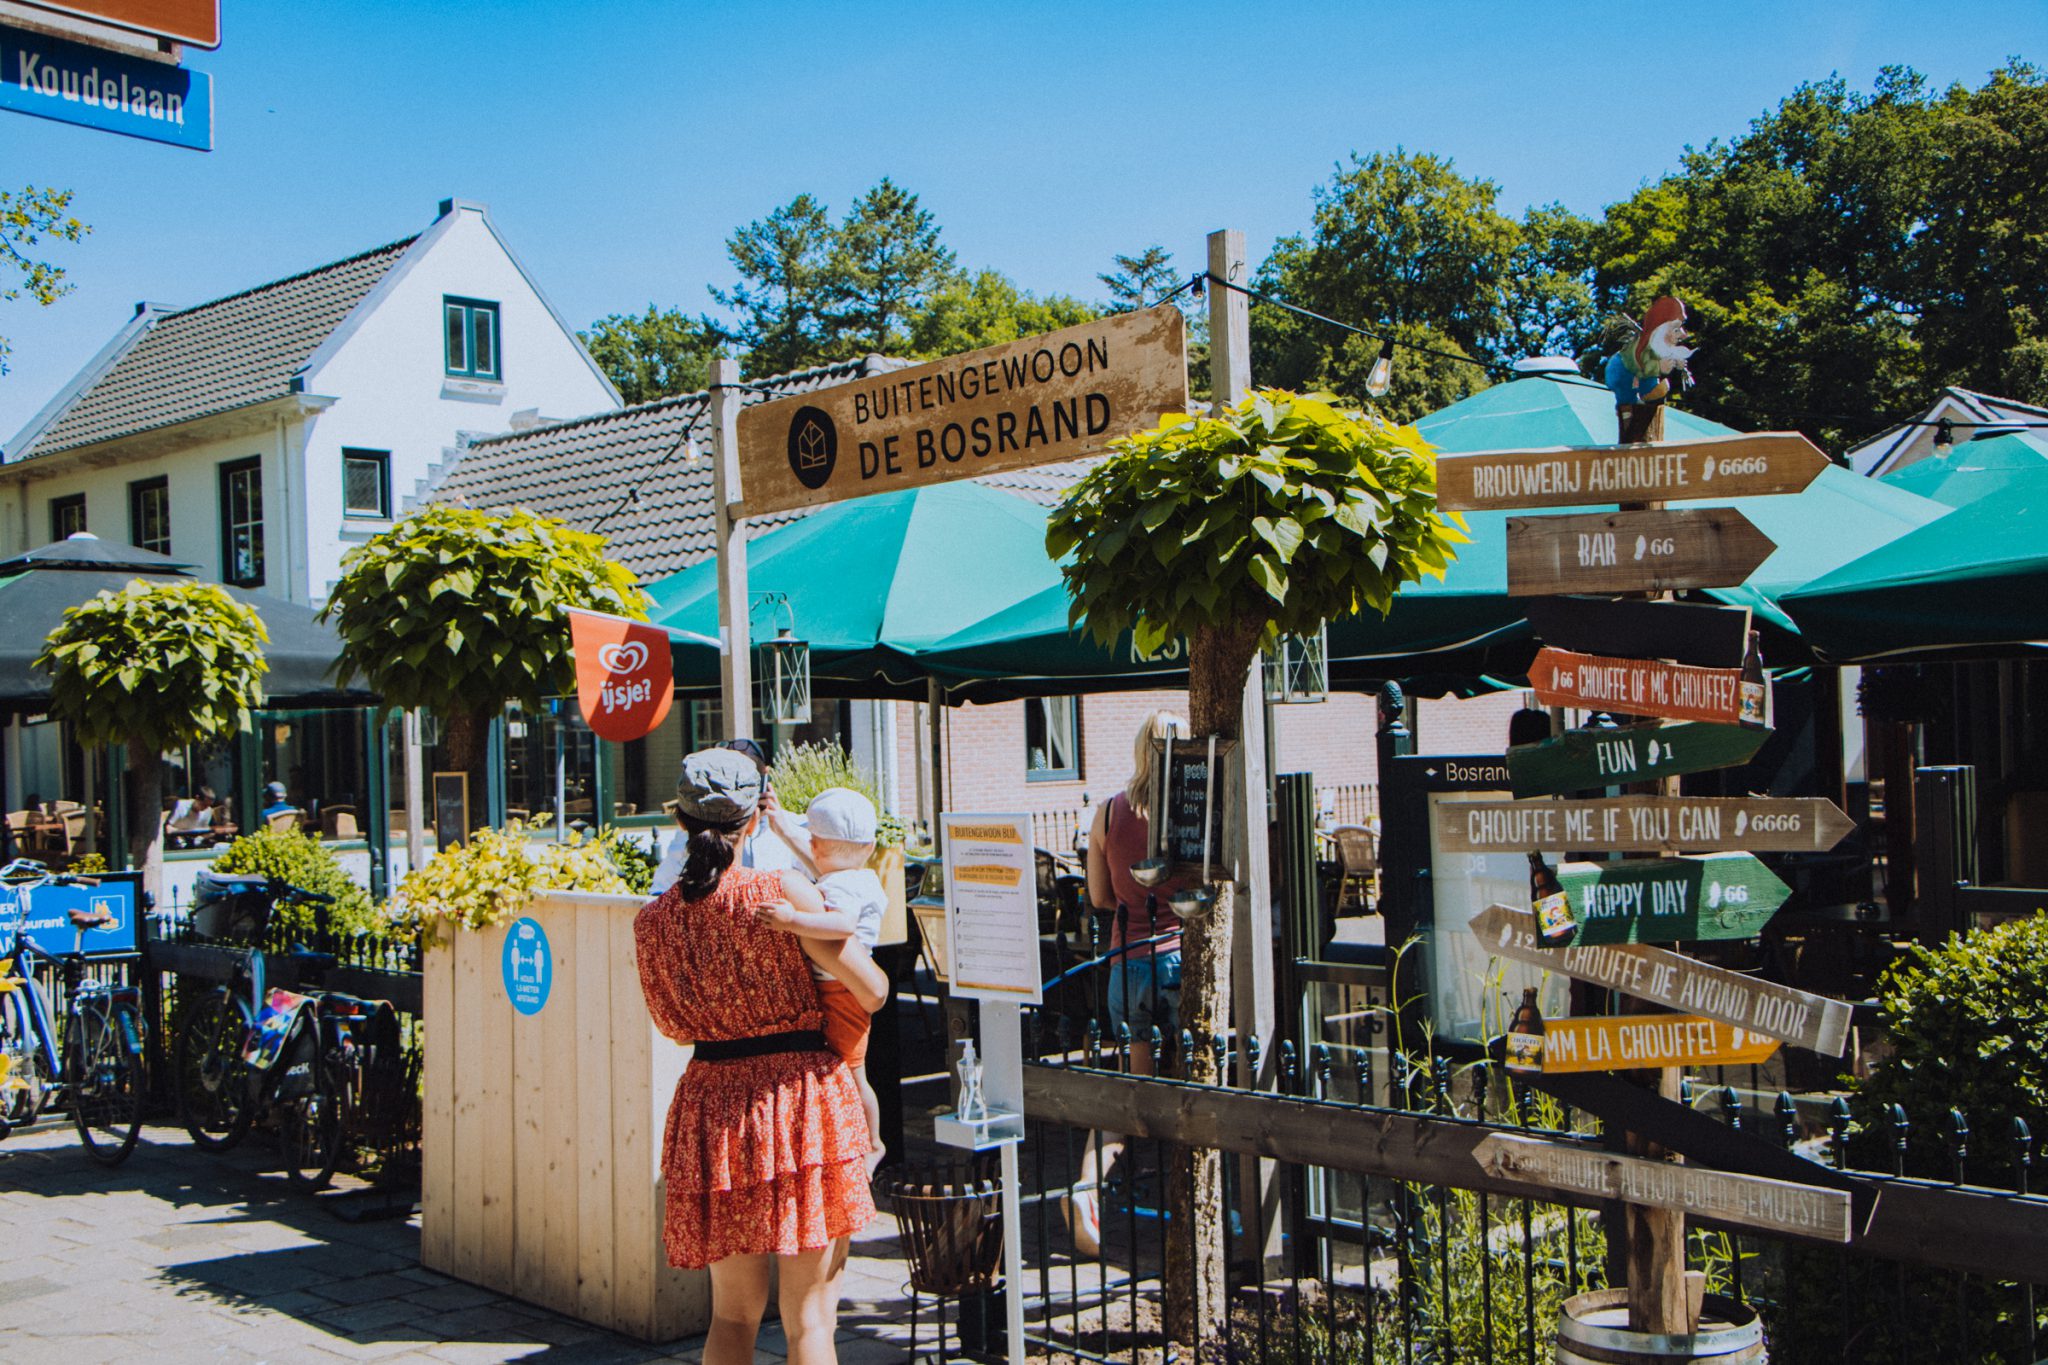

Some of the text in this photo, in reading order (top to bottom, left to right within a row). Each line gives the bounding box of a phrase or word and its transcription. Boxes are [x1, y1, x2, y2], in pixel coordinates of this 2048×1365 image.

[19, 50, 184, 124] Koudelaan
[855, 335, 1108, 425] BUITENGEWOON
[859, 392, 1111, 480] DE BOSRAND
[1473, 453, 1768, 498] BROUWERIJ ACHOUFFE 6666
[1578, 533, 1675, 568] BAR 66
[600, 679, 651, 714] ijsje?
[1560, 664, 1735, 712] 66 CHOUFFE OF MC CHOUFFE?
[1596, 739, 1674, 775] FUN 1
[1468, 806, 1800, 845] CHOUFFE ME IF YOU CAN 6666
[1583, 881, 1643, 918] HOPPY
[1652, 879, 1688, 915] DAY
[1724, 885, 1748, 903] 66
[1563, 945, 1647, 991] CHOUFFE
[1650, 962, 1678, 1000] DE
[1680, 971, 1749, 1021] AVOND
[1753, 992, 1809, 1039] DOOR
[1585, 1026, 1612, 1061] LA
[1619, 1021, 1717, 1060] CHOUFFE!
[1620, 1160, 1676, 1203] ALTIJD
[1683, 1172, 1728, 1210] GOED
